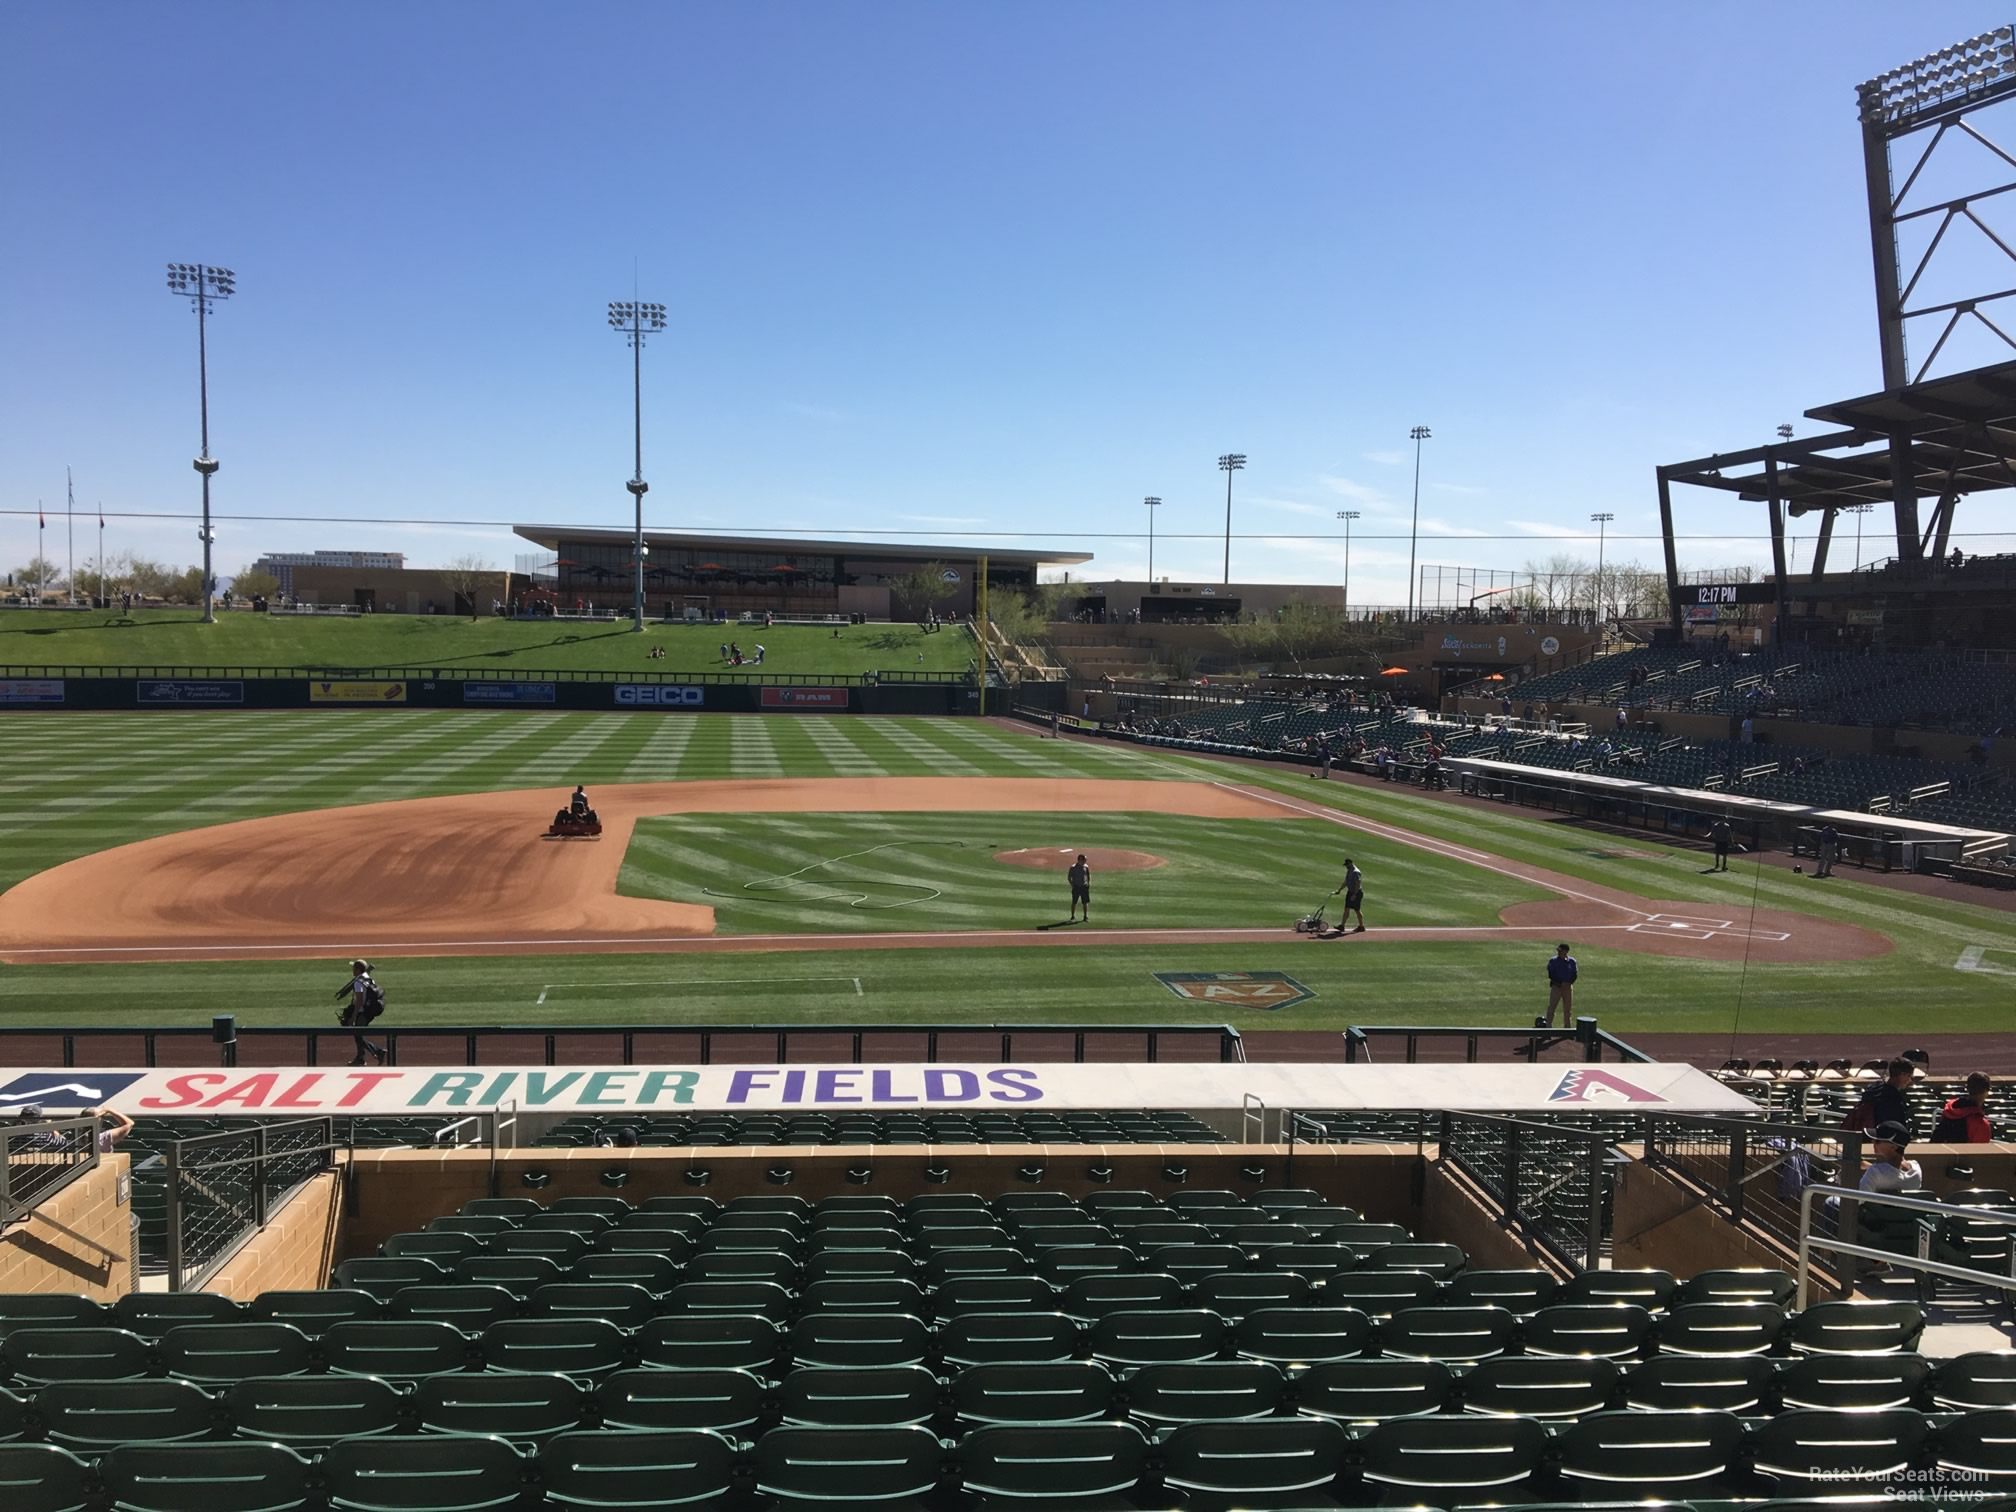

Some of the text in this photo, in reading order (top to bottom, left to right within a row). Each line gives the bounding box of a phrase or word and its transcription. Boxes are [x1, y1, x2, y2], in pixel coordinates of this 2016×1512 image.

[1699, 586, 1736, 602] 12:17 PM
[615, 687, 703, 704] GEICO
[794, 693, 831, 702] RAM
[1204, 984, 1291, 998] AZ
[139, 1068, 1045, 1108] SALT RIVER FIELDS
